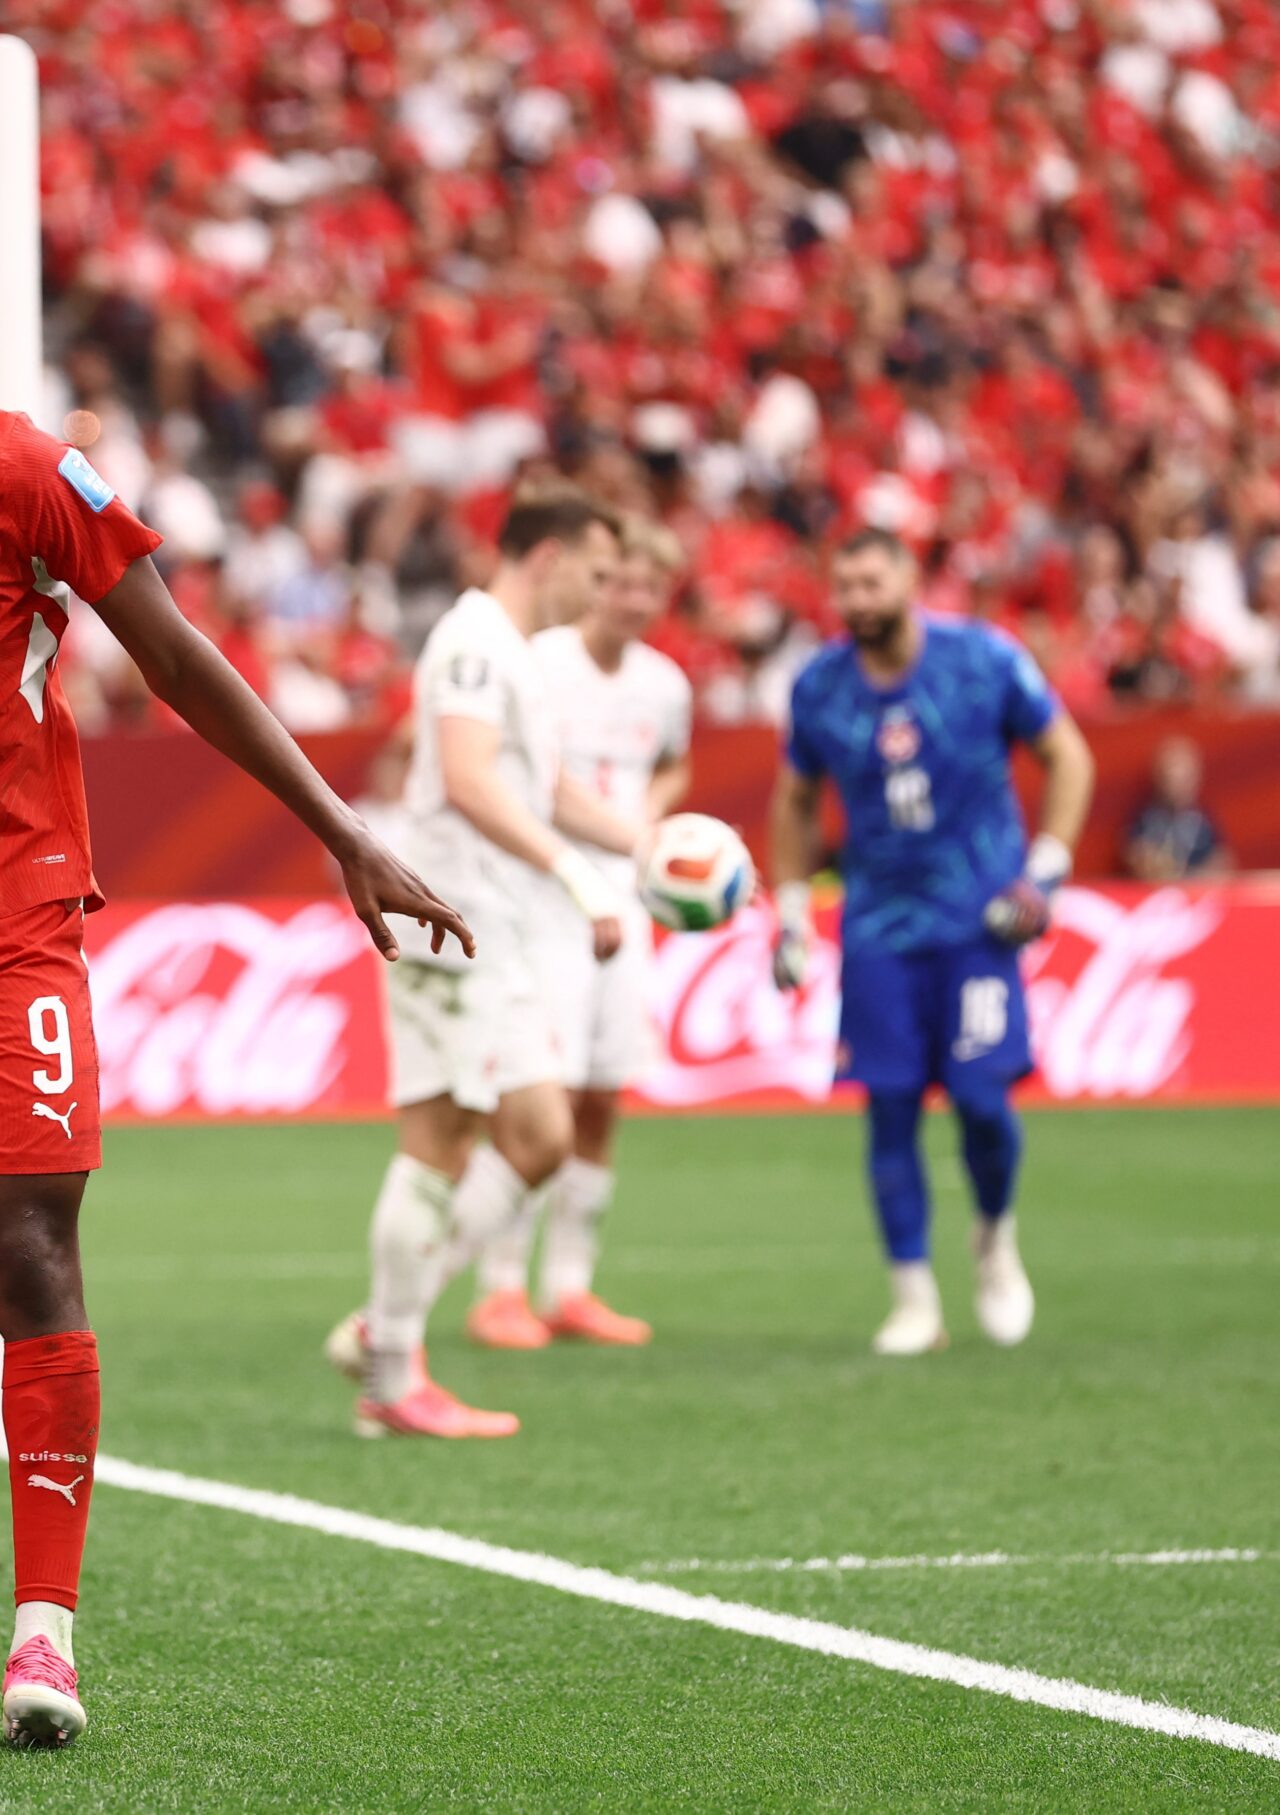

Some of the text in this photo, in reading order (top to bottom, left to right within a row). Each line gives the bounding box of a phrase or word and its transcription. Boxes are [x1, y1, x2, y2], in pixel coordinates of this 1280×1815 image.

[961, 976, 1008, 1044] 16
[27, 995, 74, 1095] 9
[19, 1450, 88, 1463] suisse
